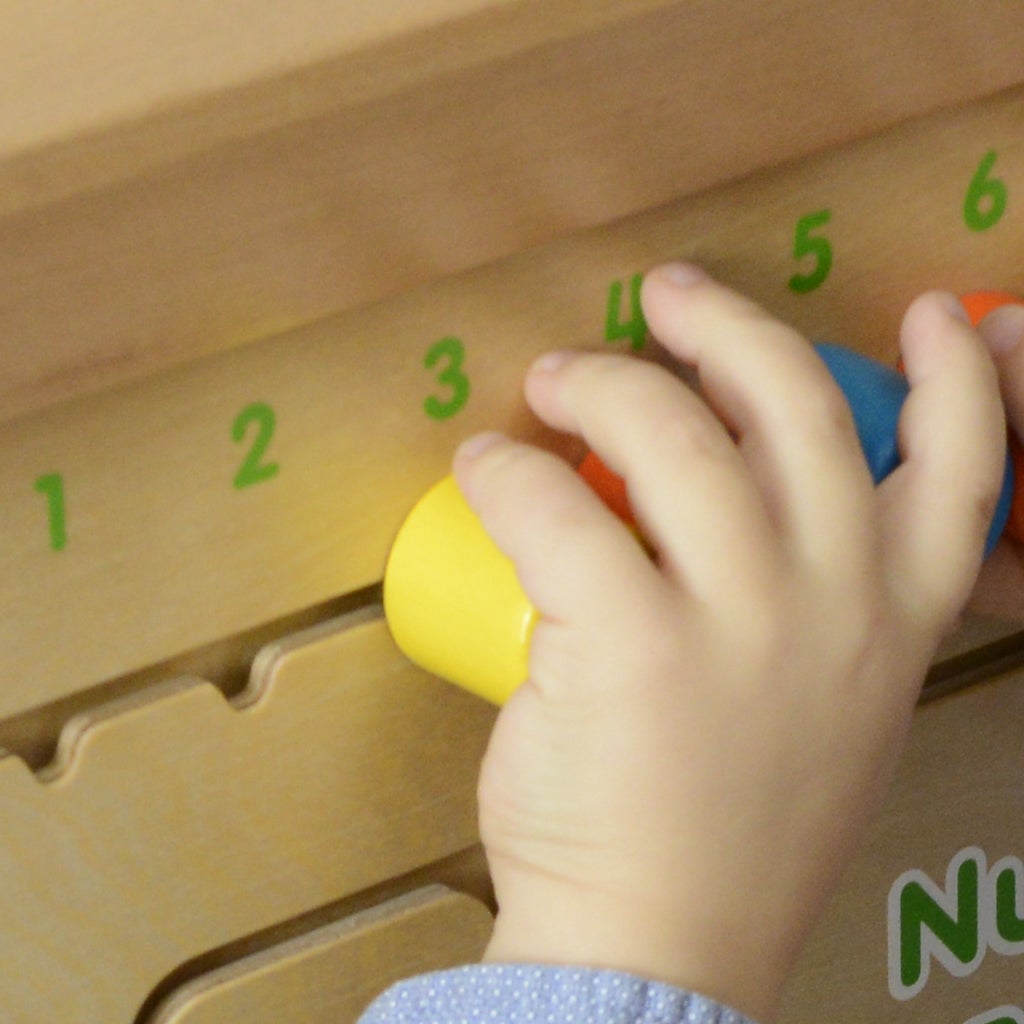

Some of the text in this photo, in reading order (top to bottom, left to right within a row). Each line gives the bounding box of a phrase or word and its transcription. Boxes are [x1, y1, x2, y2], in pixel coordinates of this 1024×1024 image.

[32, 471, 69, 553] 1
[229, 402, 281, 491] 2
[422, 336, 471, 422] 3
[603, 272, 648, 351] 4
[788, 208, 834, 294] 5
[961, 150, 1009, 234] 6
